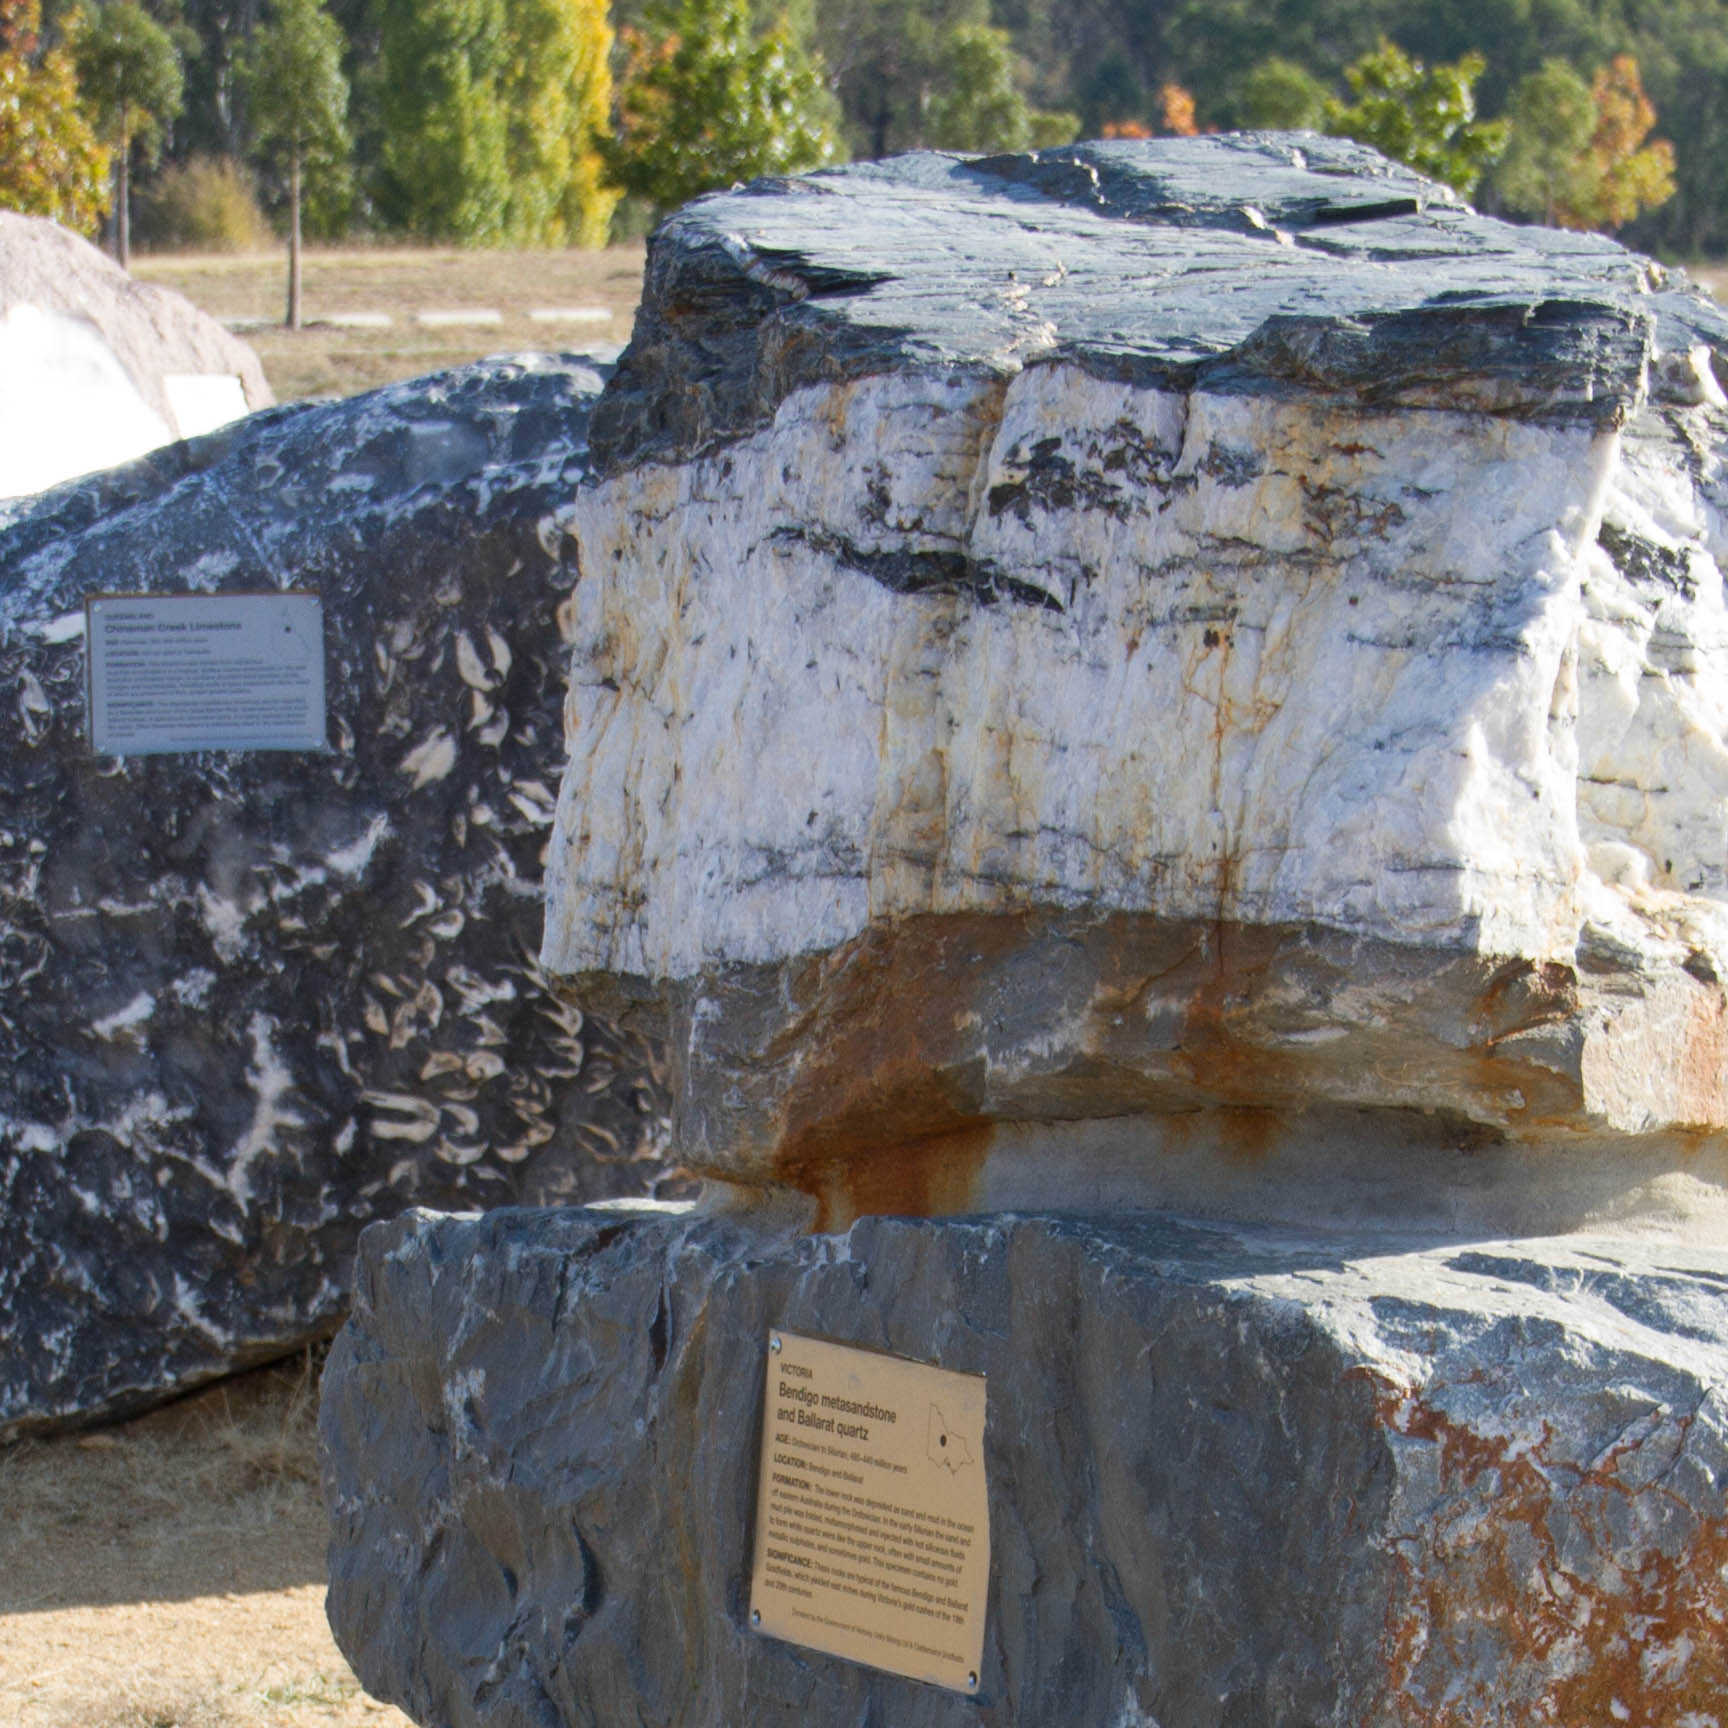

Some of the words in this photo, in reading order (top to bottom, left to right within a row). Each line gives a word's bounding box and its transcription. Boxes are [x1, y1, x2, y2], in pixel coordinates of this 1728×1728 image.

[158, 623, 187, 632] Creek
[190, 622, 242, 631] Limestone
[780, 1363, 812, 1379] VICTORIA
[779, 1382, 819, 1407] Bendigo
[821, 1396, 896, 1423] metasandstone
[777, 1408, 795, 1422] and
[797, 1410, 834, 1432] Ballarat
[836, 1423, 868, 1441] quartz
[774, 1452, 807, 1469] LOCATION:
